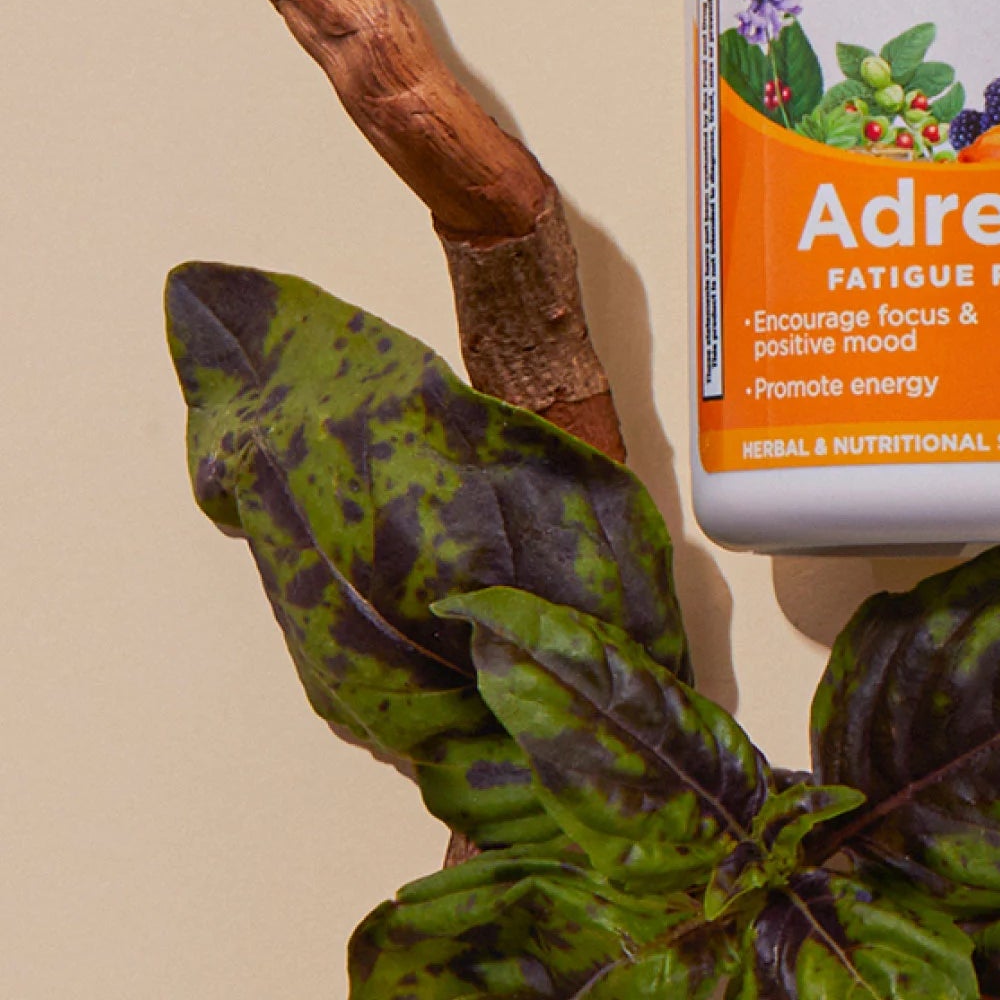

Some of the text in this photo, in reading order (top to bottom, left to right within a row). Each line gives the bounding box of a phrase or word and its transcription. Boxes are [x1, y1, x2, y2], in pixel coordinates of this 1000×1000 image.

[828, 264, 974, 290] FATIGUE
[754, 302, 978, 333] Encourage focus &
[754, 329, 917, 361] positive mood
[754, 374, 939, 400] Promote energy
[742, 438, 810, 459] HERBAL
[813, 437, 828, 456] &
[833, 433, 991, 455] NUTRITIONAL
